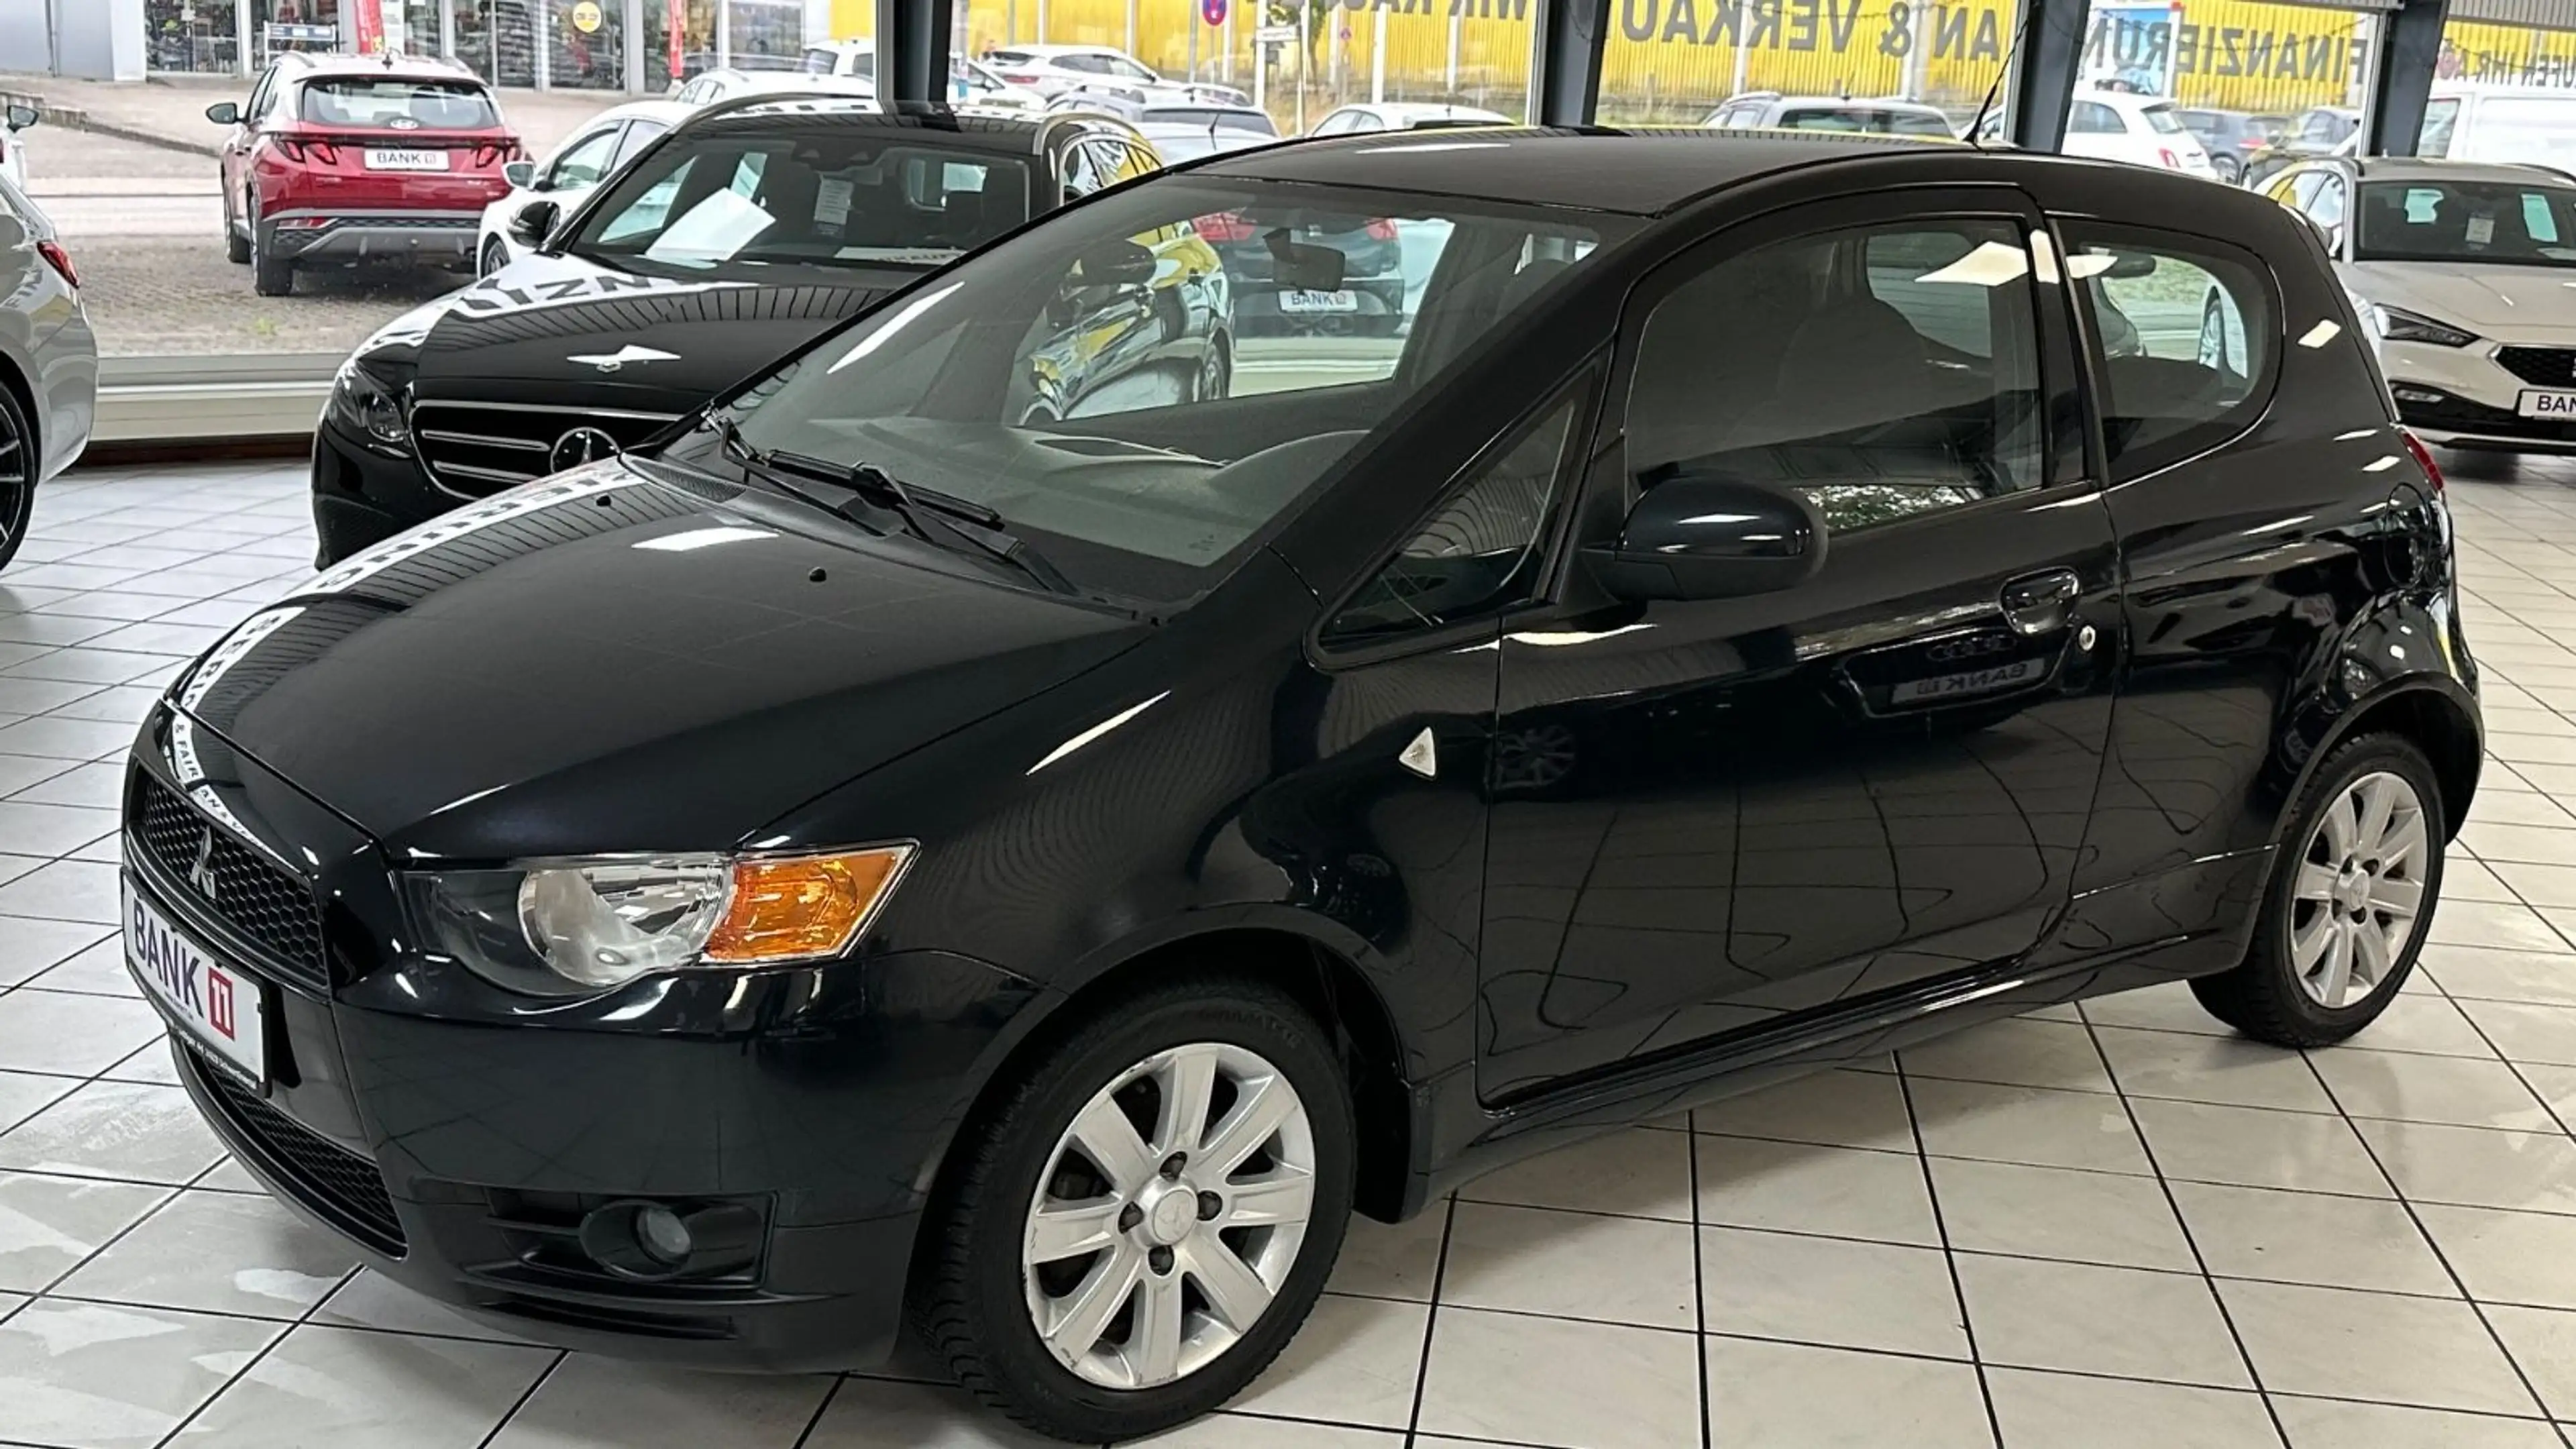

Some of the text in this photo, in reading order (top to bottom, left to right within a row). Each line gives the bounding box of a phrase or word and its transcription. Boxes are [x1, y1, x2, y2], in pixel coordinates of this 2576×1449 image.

[376, 152, 421, 165] BANK
[133, 899, 233, 1036] BANK 11
